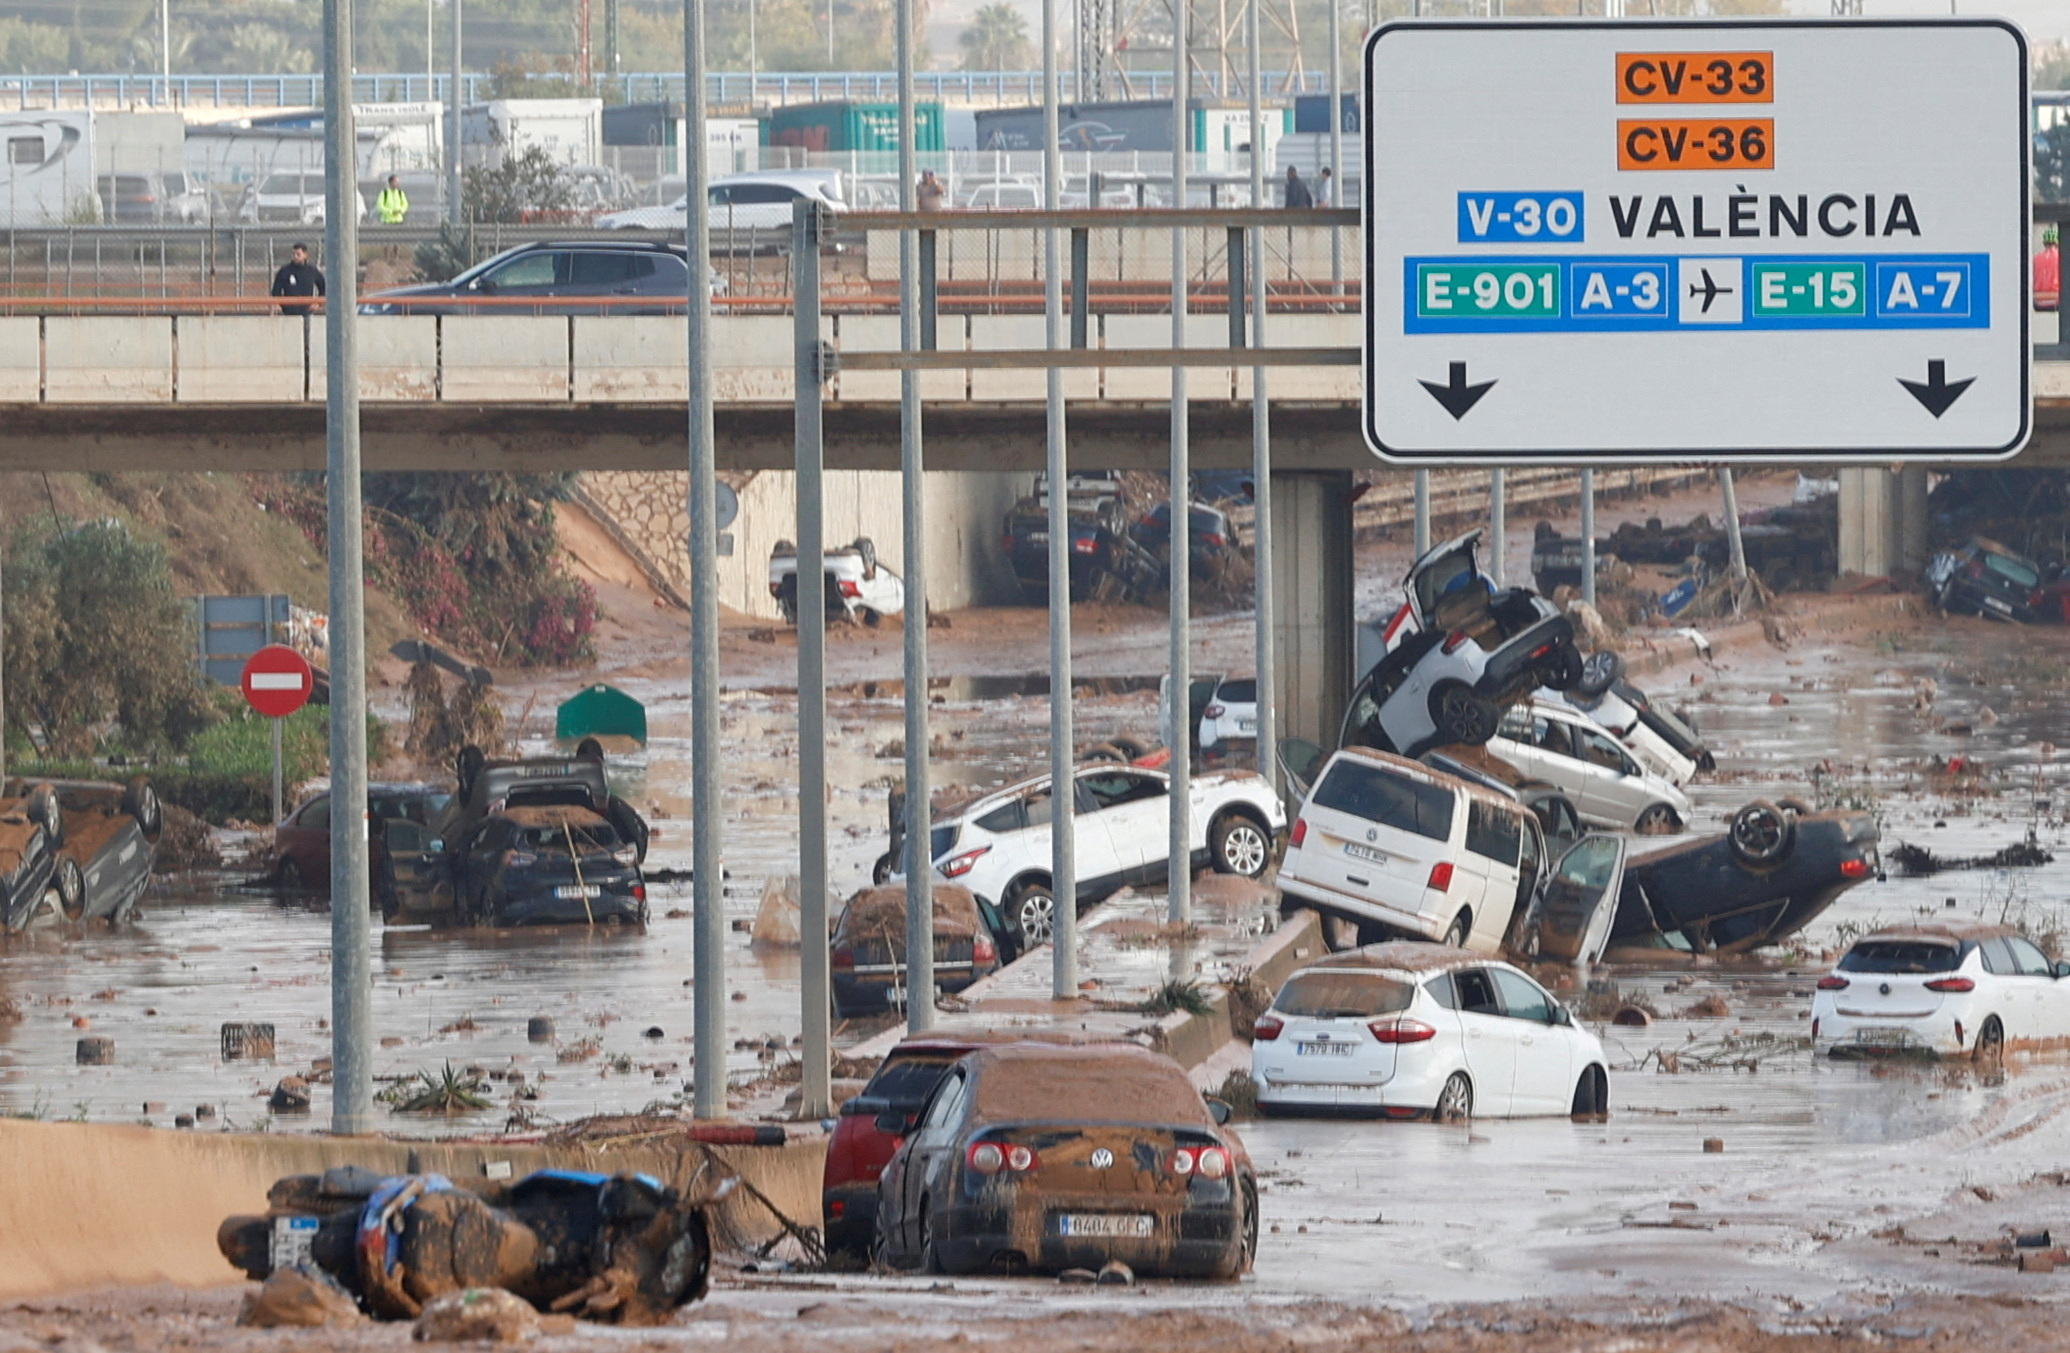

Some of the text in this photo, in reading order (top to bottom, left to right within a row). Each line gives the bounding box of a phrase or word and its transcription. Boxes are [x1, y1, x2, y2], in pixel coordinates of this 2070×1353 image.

[1624, 60, 1766, 96] CV-33
[1626, 126, 1767, 162] CV-36
[1467, 184, 1922, 238] V-30 VALÈNCIA
[1425, 272, 1962, 309] E-901 A-3 E-15 A-7
